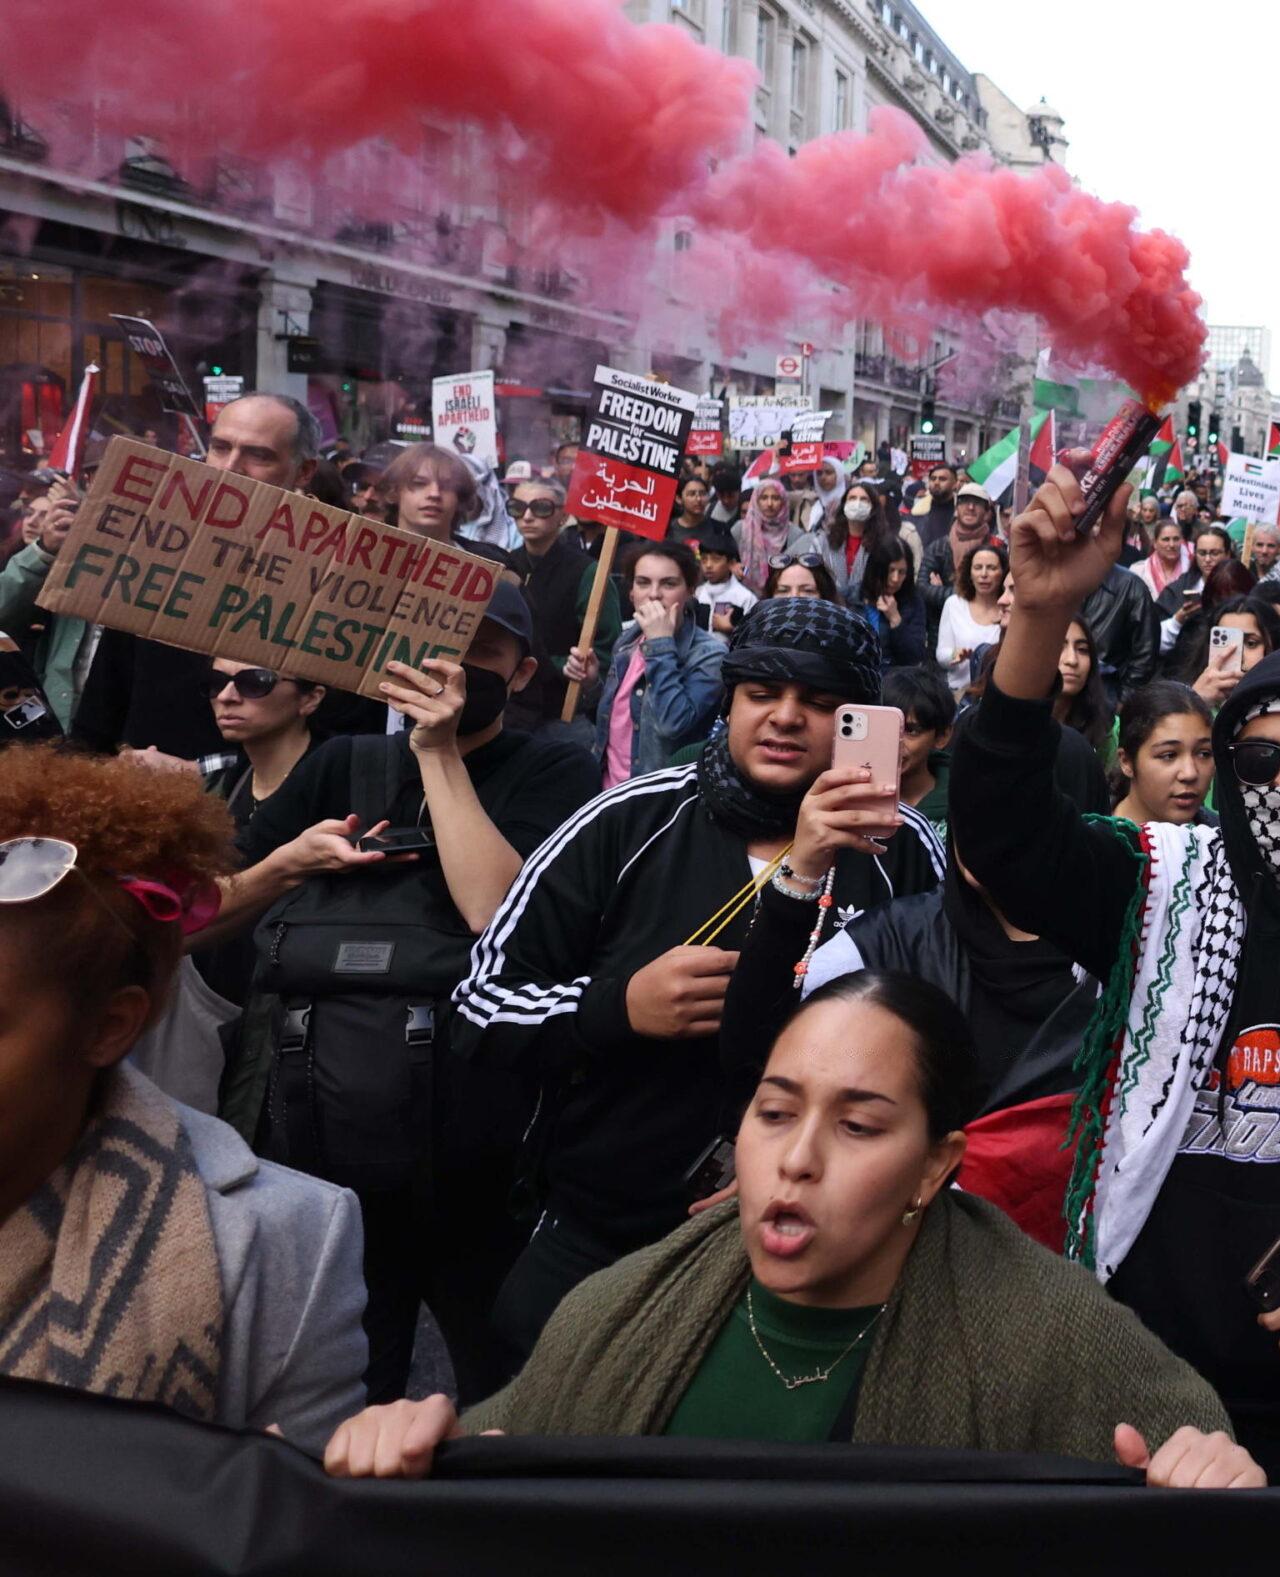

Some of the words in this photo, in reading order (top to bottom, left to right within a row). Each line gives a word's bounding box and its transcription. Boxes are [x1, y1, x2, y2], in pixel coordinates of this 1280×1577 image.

[445, 395, 480, 412] ISRAELI
[453, 384, 471, 399] END
[611, 374, 649, 395] Socialist
[650, 386, 682, 404] Worker
[438, 408, 490, 427] APARTHEID
[599, 389, 683, 437] FREEDOM
[629, 421, 645, 438] for
[586, 423, 679, 473] PALESTINE
[596, 462, 655, 495] الحرية
[1228, 474, 1278, 492] Palestinian
[1239, 487, 1264, 500] Lives
[581, 489, 658, 522] لفلسطين
[1232, 499, 1265, 514] Matter
[113, 455, 250, 529] END
[255, 503, 494, 602] APARTHEID
[64, 543, 206, 620] FREE
[97, 504, 190, 553] END
[212, 536, 292, 585] THE
[310, 566, 476, 636] VIOLENCE
